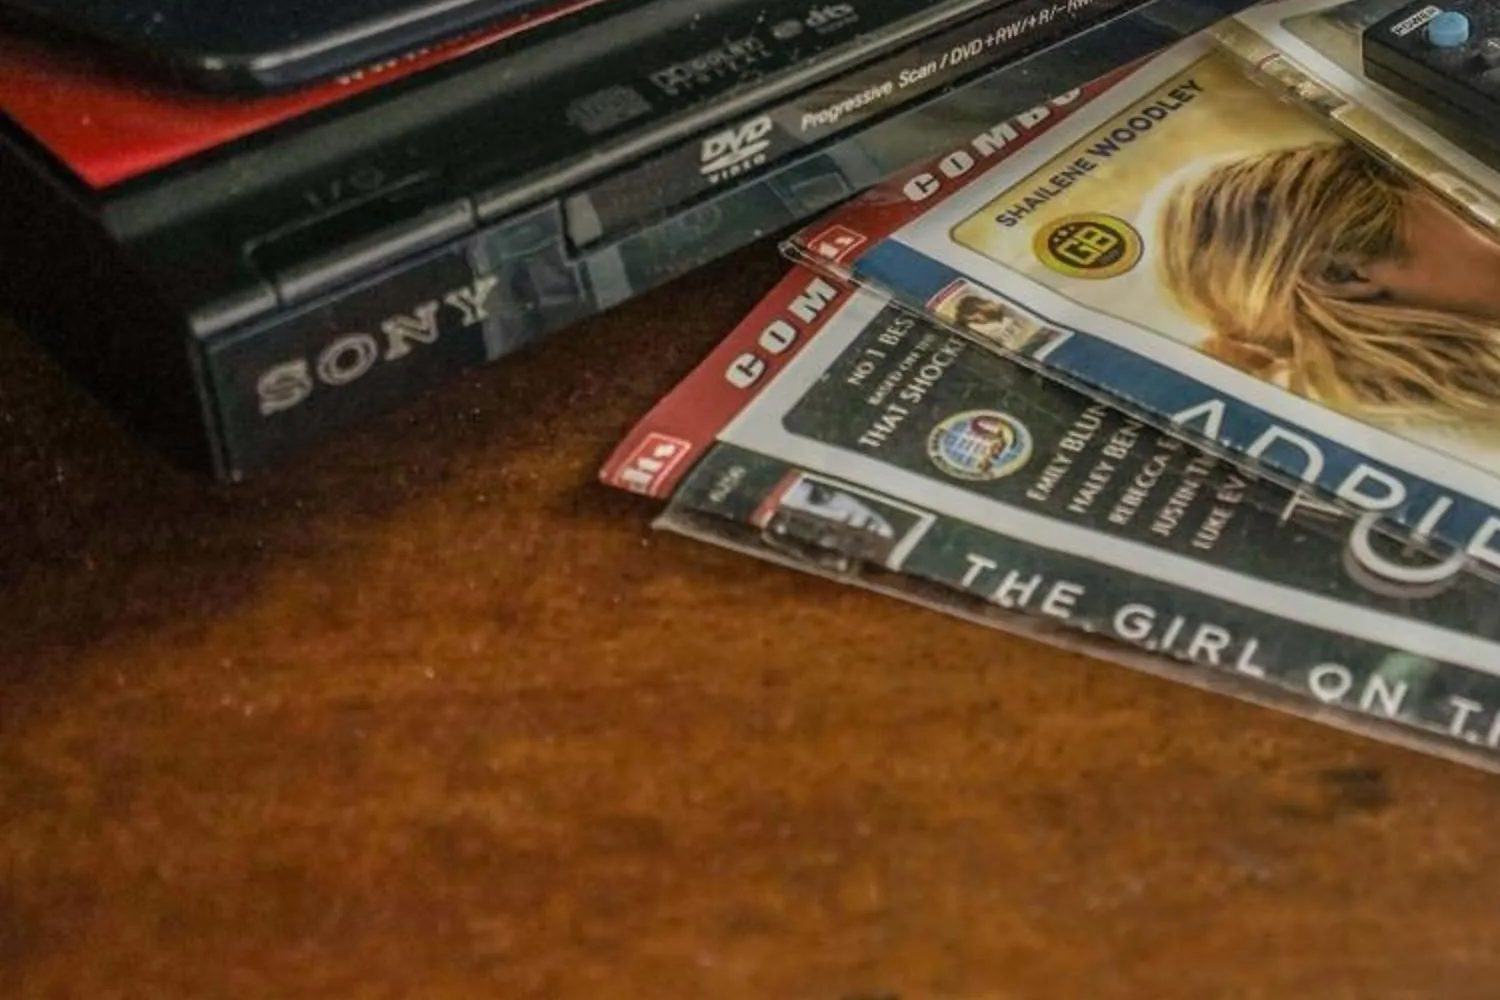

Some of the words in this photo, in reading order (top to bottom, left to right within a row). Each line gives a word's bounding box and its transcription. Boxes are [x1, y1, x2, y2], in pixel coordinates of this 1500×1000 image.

[800, 81, 893, 133] Progressive
[898, 57, 938, 88] Scan
[700, 115, 772, 162] DVD
[994, 159, 1096, 229] SHAILENE
[1090, 79, 1205, 169] WOODLEY
[256, 273, 500, 417] SONY
[847, 360, 876, 386] NO
[857, 402, 910, 448] THAT
[1025, 453, 1073, 502] EMILY
[1068, 460, 1116, 514] HALEY
[1107, 453, 1172, 526] REBECCA
[1191, 507, 1236, 550] LUKE
[961, 554, 1084, 620] THE
[1113, 604, 1267, 679] GIRL
[1308, 664, 1408, 718] ON
